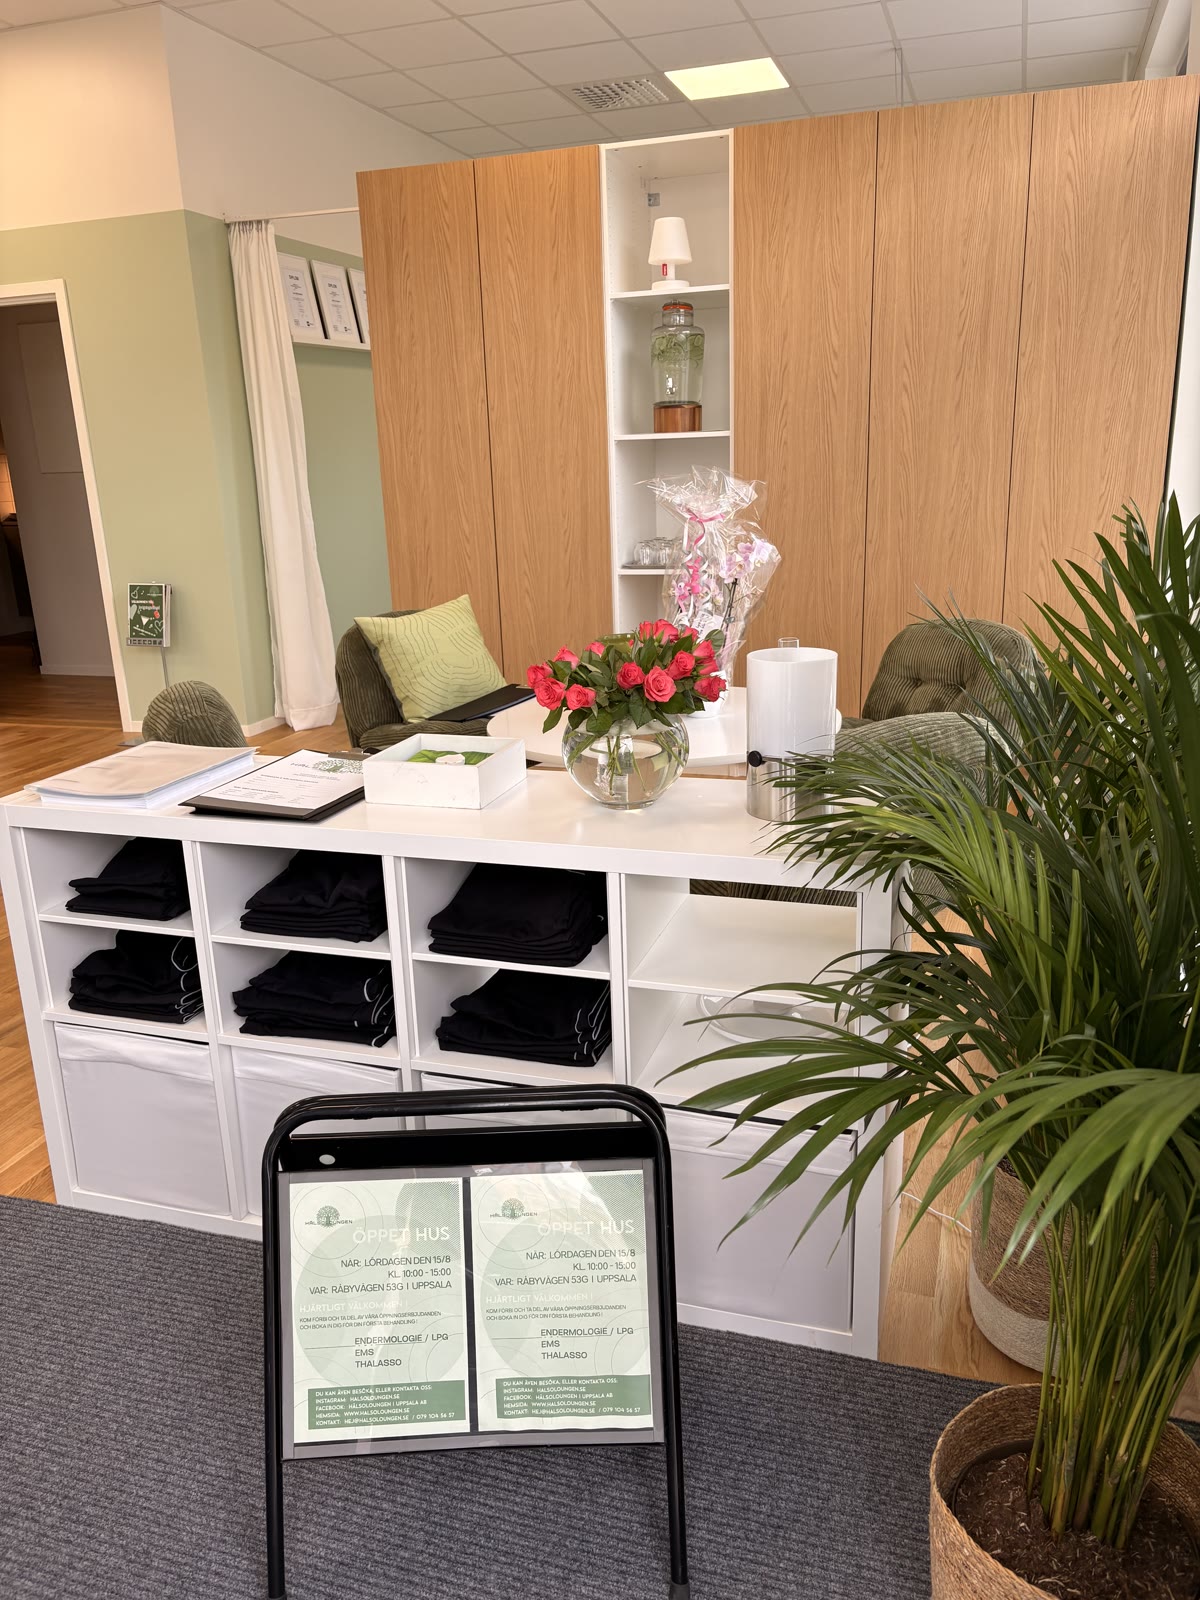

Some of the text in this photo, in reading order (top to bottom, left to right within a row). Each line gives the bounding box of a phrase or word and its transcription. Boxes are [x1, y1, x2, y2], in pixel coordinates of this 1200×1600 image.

[601, 1219, 635, 1234] HUS
[353, 1226, 450, 1244] ÖPPET HUS
[526, 1251, 547, 1260] NÄR:
[550, 1250, 597, 1259] LÖRDAGEN
[618, 1249, 635, 1257] 15/8
[341, 1256, 450, 1268] NÄR: LÖRDAGEN DEN 15/8
[588, 1262, 608, 1270] 10:00
[403, 1269, 423, 1277] 10:00
[431, 1268, 451, 1276] 15:00
[495, 1278, 513, 1286] VAR:
[517, 1276, 569, 1285] RÅBYVÄGEN
[597, 1274, 636, 1283] UPPSALA
[309, 1286, 328, 1295] VAR:
[332, 1283, 384, 1294] RÅBYVÄGEN
[412, 1281, 452, 1290] UPPSALA
[486, 1295, 530, 1304] HJÄRTLIGT
[534, 1293, 587, 1301] VÄLKOMMEN
[300, 1302, 345, 1313] HJÄRTLIGT
[349, 1301, 402, 1310] VÄLKOMMEN
[541, 1328, 607, 1336] ENDERMOLOGIE
[355, 1334, 422, 1345] ENDERMOLOGIE
[541, 1340, 560, 1348] EMS
[541, 1352, 587, 1360] THALASSO
[355, 1359, 402, 1368] THALASSO
